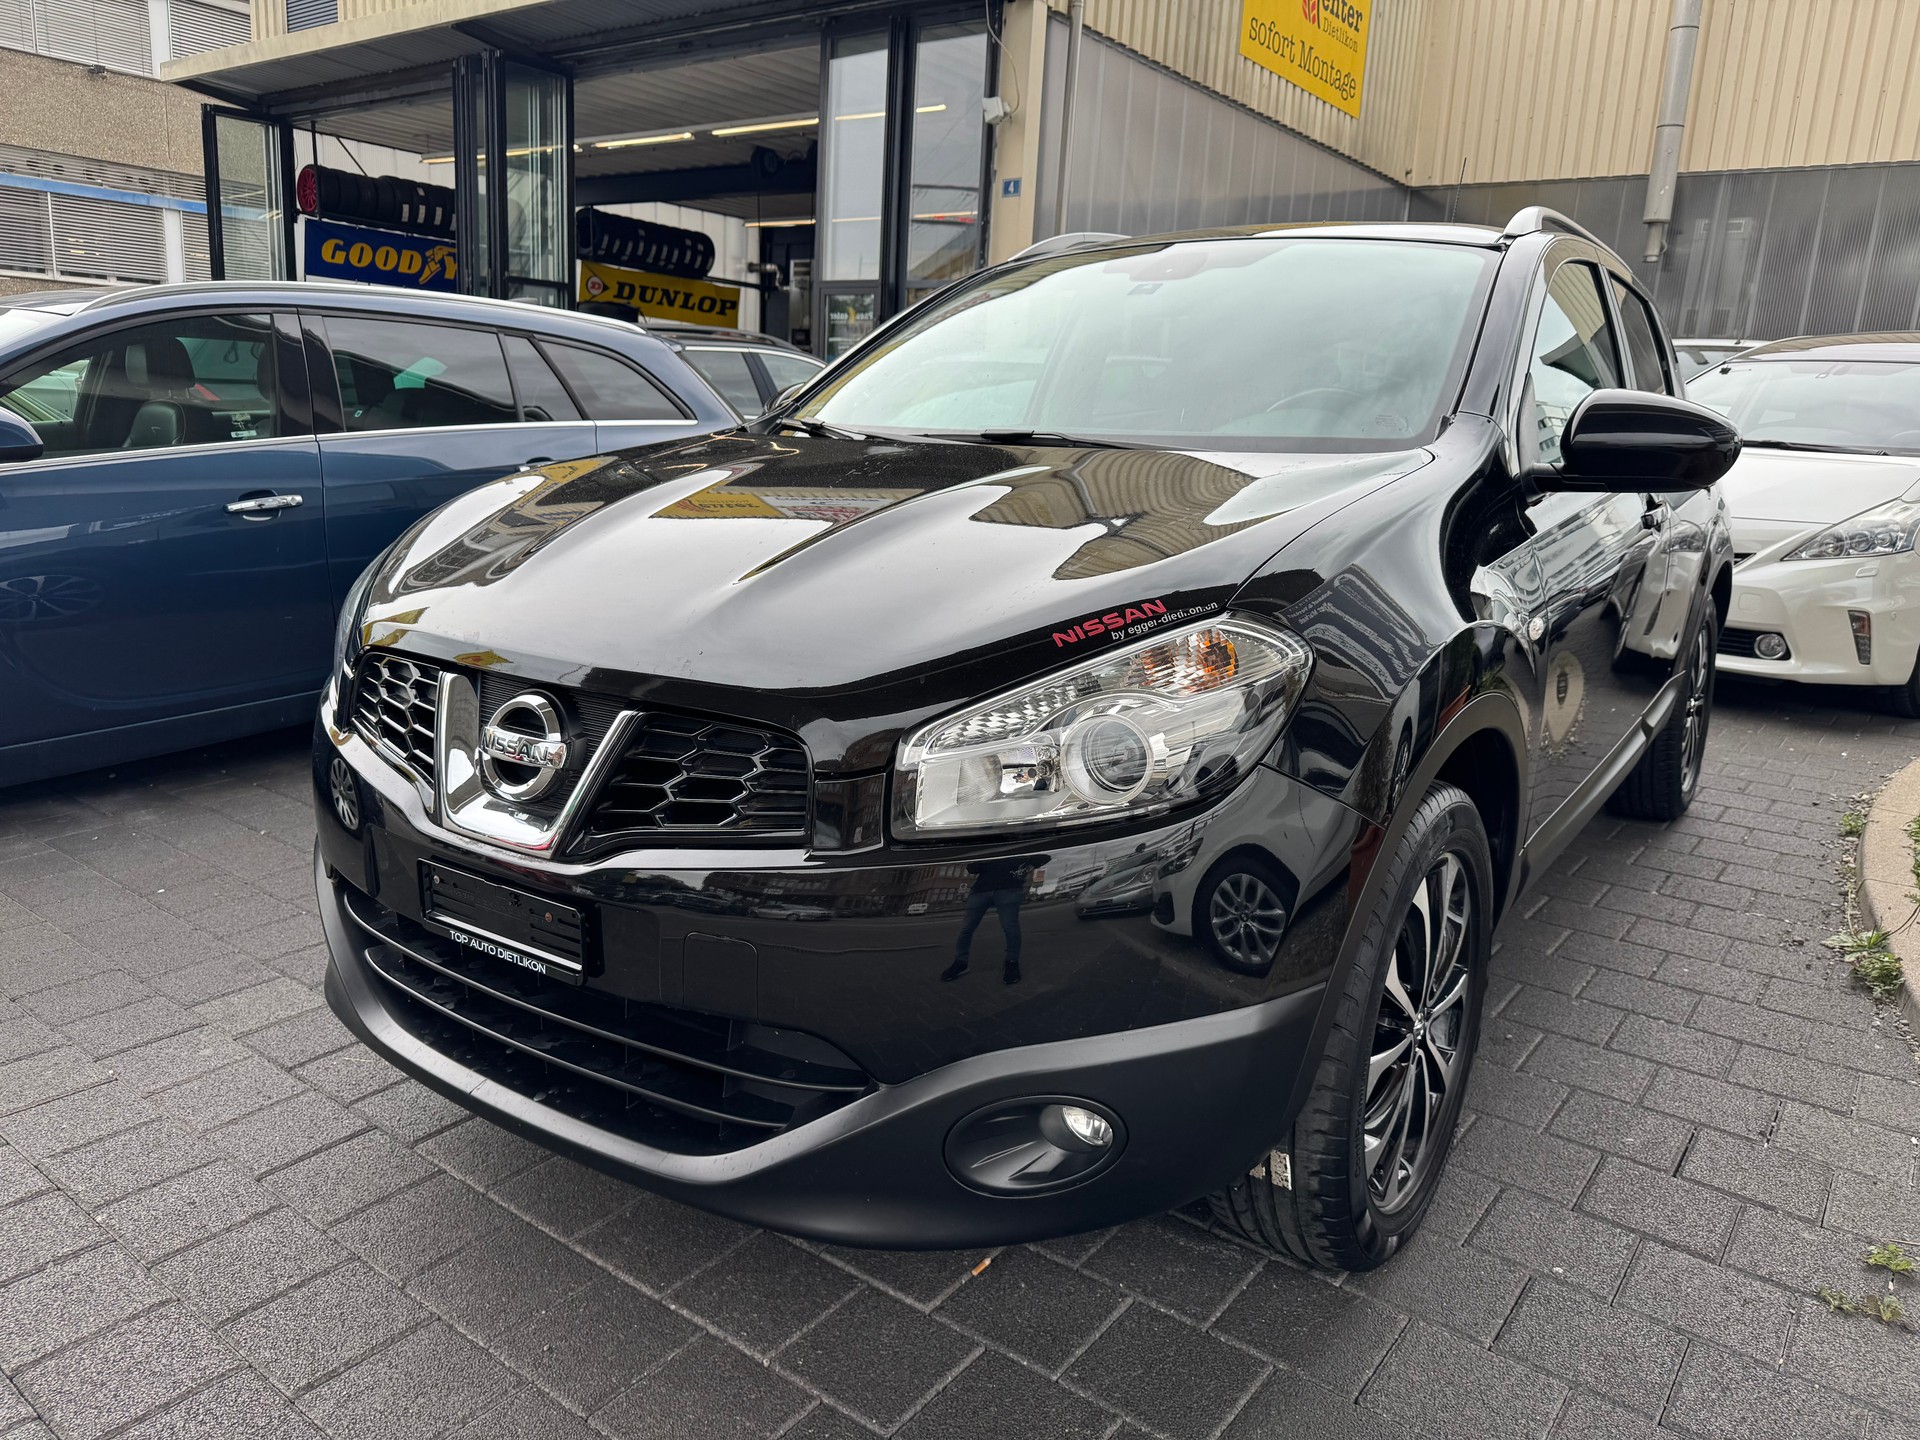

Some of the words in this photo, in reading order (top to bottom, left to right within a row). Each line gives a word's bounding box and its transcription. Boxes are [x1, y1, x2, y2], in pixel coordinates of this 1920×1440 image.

[1322, 16, 1358, 53] Dietlikon
[1249, 17, 1295, 63] sofort
[1298, 40, 1357, 101] Montage
[613, 281, 737, 316] DUNLOP
[1052, 599, 1167, 648] NISSAN
[1111, 628, 1126, 641] by
[482, 730, 549, 762] NISSAN
[450, 930, 469, 944] TOP
[470, 938, 496, 955] AUTO
[497, 948, 546, 974] DIETLIKON
